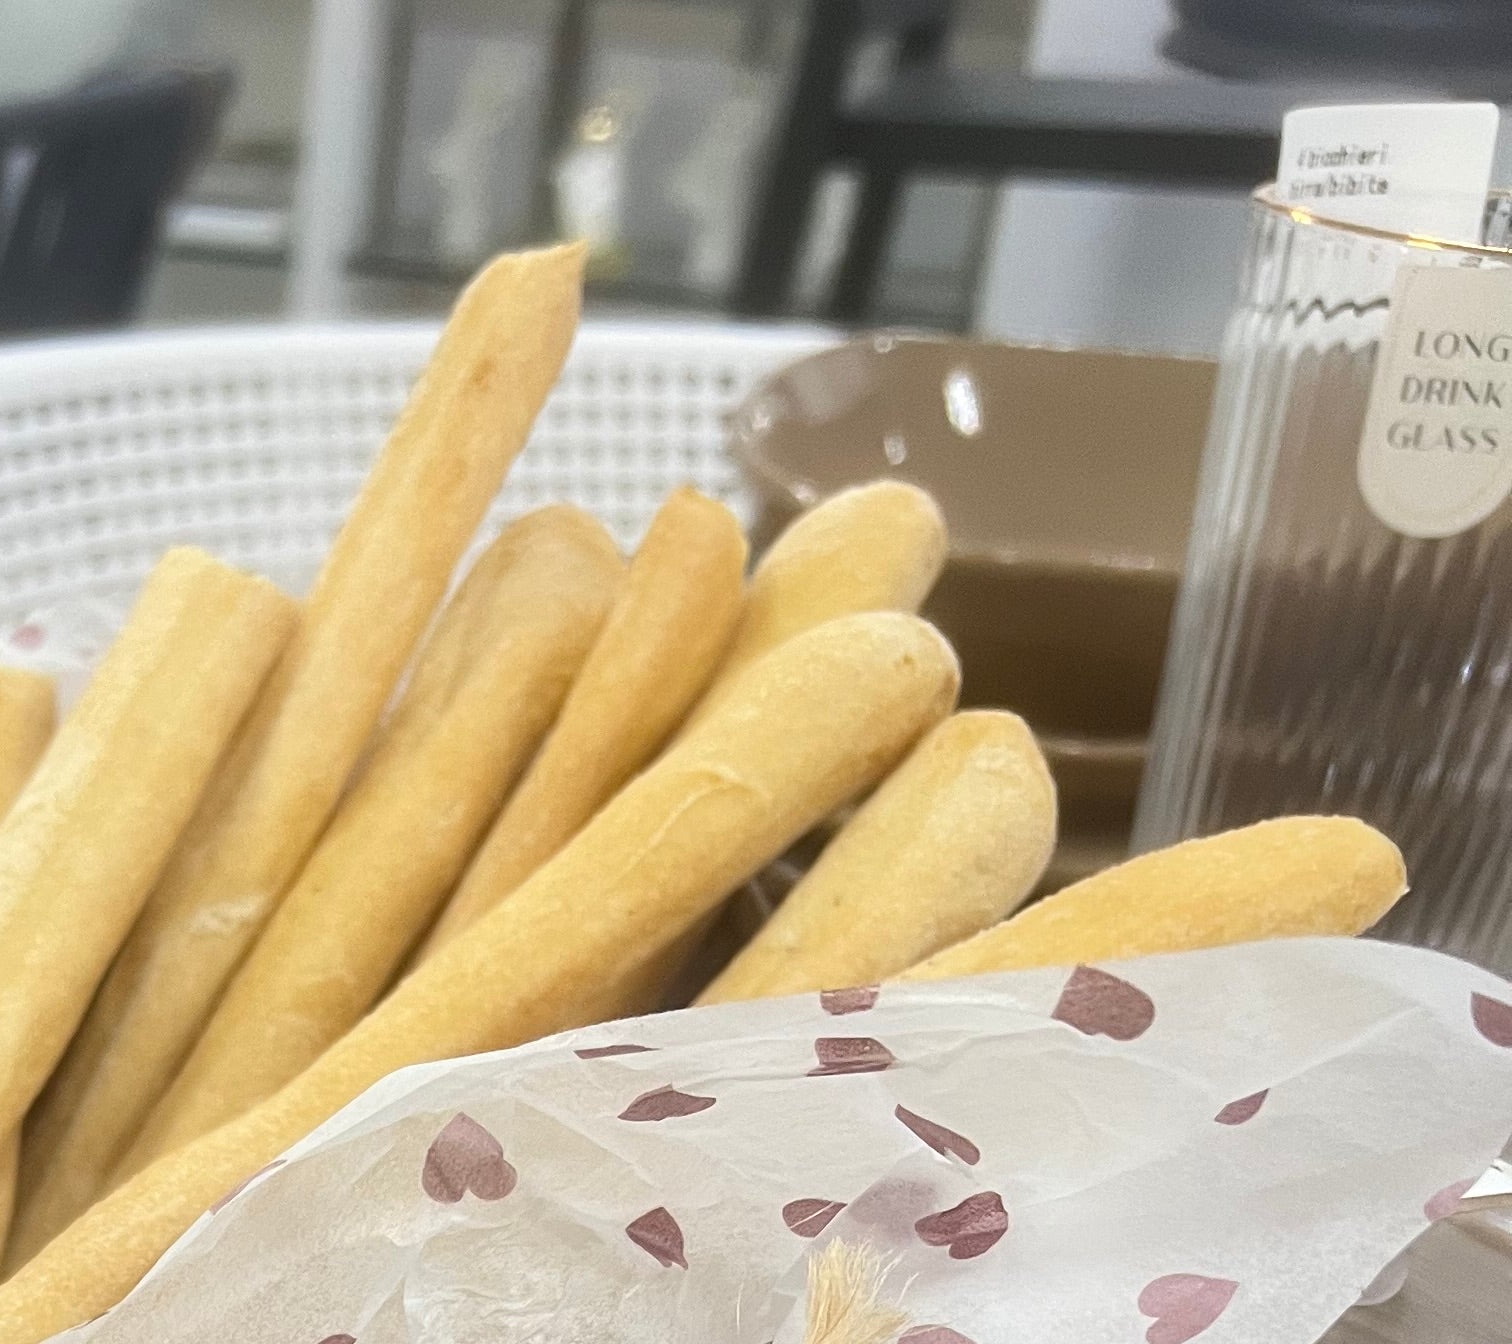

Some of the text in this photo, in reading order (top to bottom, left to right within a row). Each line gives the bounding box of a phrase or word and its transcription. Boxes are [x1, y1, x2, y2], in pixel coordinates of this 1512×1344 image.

[1415, 330, 1512, 362] LONG
[1400, 373, 1508, 409] DRINK
[1387, 419, 1499, 454] GLASS
